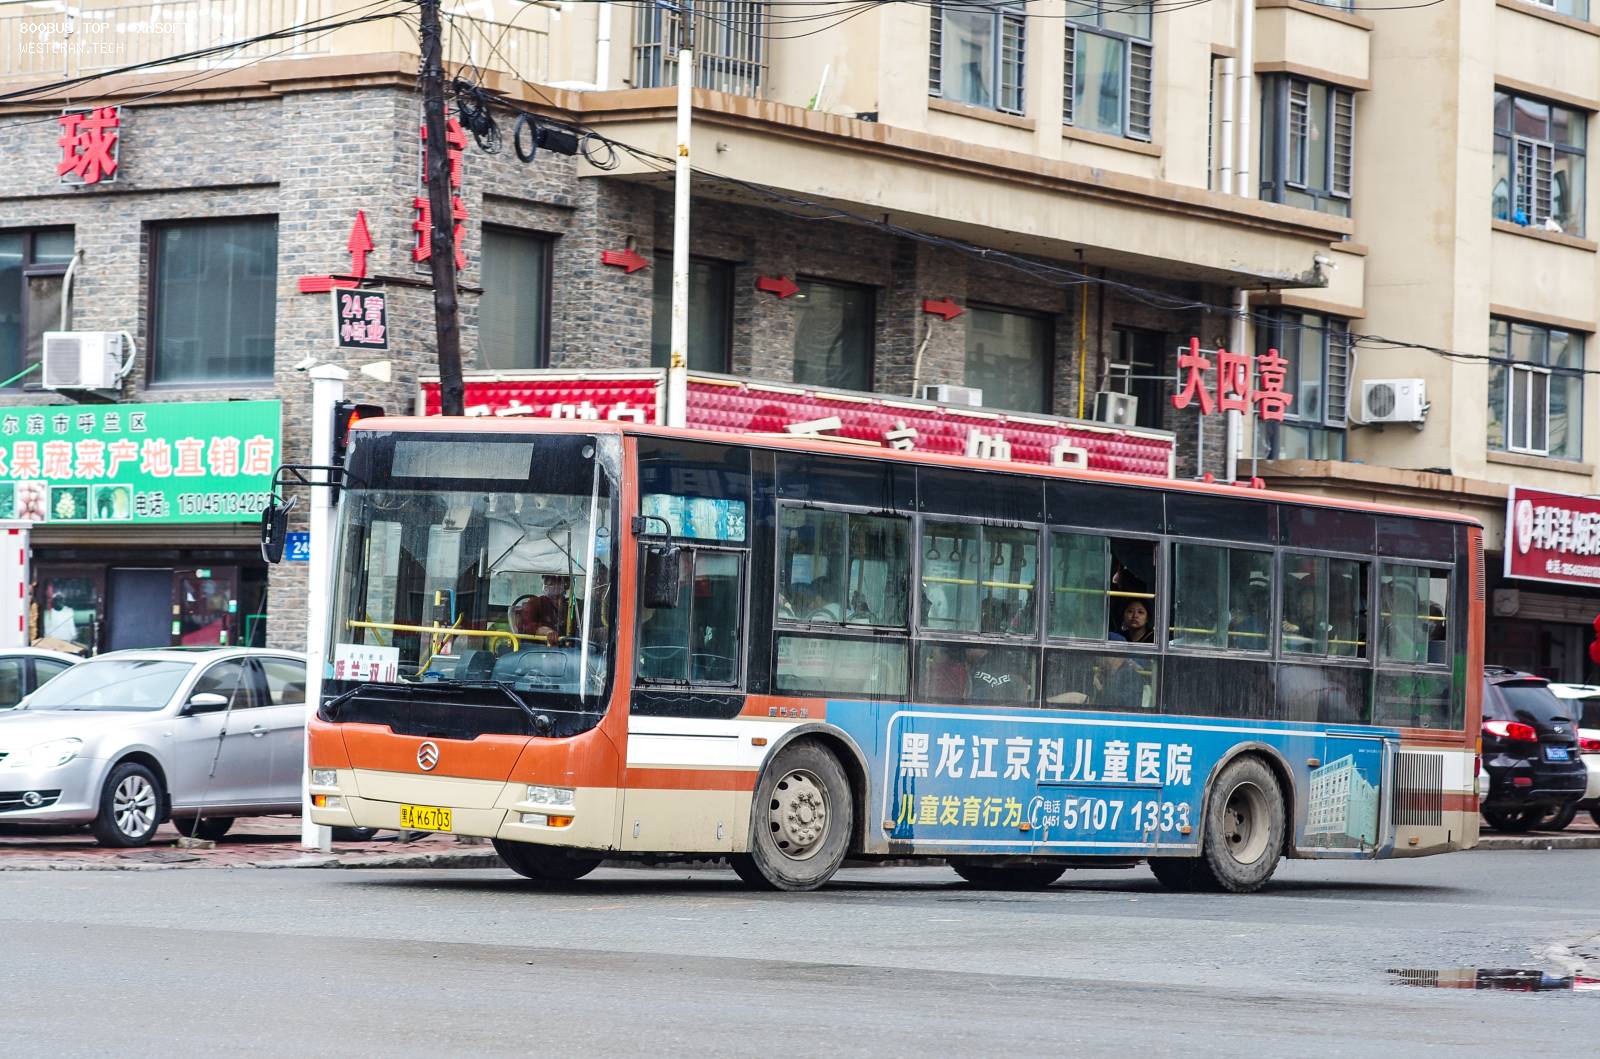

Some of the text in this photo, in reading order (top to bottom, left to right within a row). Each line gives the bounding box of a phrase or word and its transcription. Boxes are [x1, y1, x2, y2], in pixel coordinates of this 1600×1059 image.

[57, 106, 120, 184] 球
[1171, 336, 1293, 422] 大四喜
[900, 733, 1193, 786] 黑龙江京科儿童医院
[897, 793, 1023, 828] 儿童发育行为
[1044, 800, 1061, 814] 电话
[1064, 799, 1191, 832] 5107 1333
